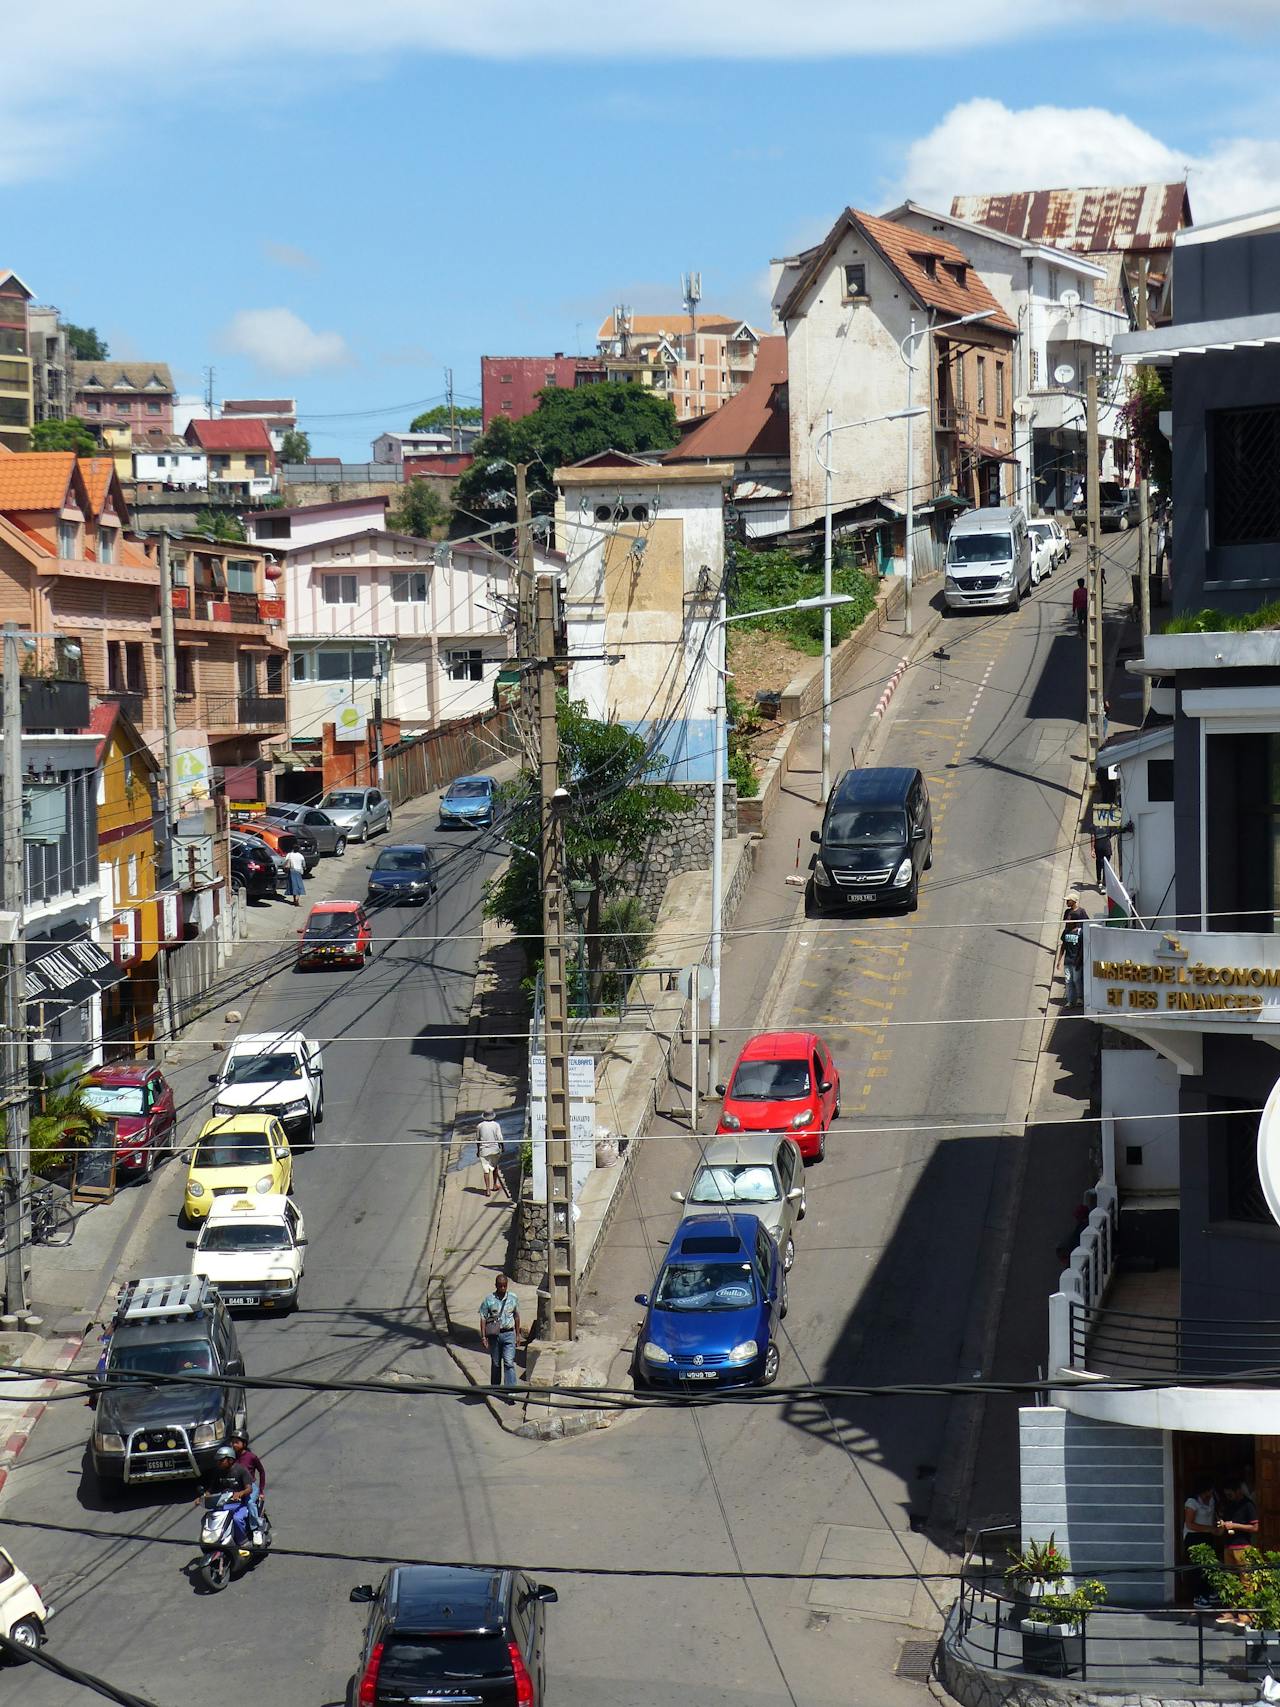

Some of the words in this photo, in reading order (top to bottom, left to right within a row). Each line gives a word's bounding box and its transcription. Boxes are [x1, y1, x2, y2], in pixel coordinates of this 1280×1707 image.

[1152, 965, 1175, 985] DE
[1106, 988, 1125, 1007] ET
[1128, 990, 1158, 1010] DES
[1166, 991, 1264, 1015] FINANCES
